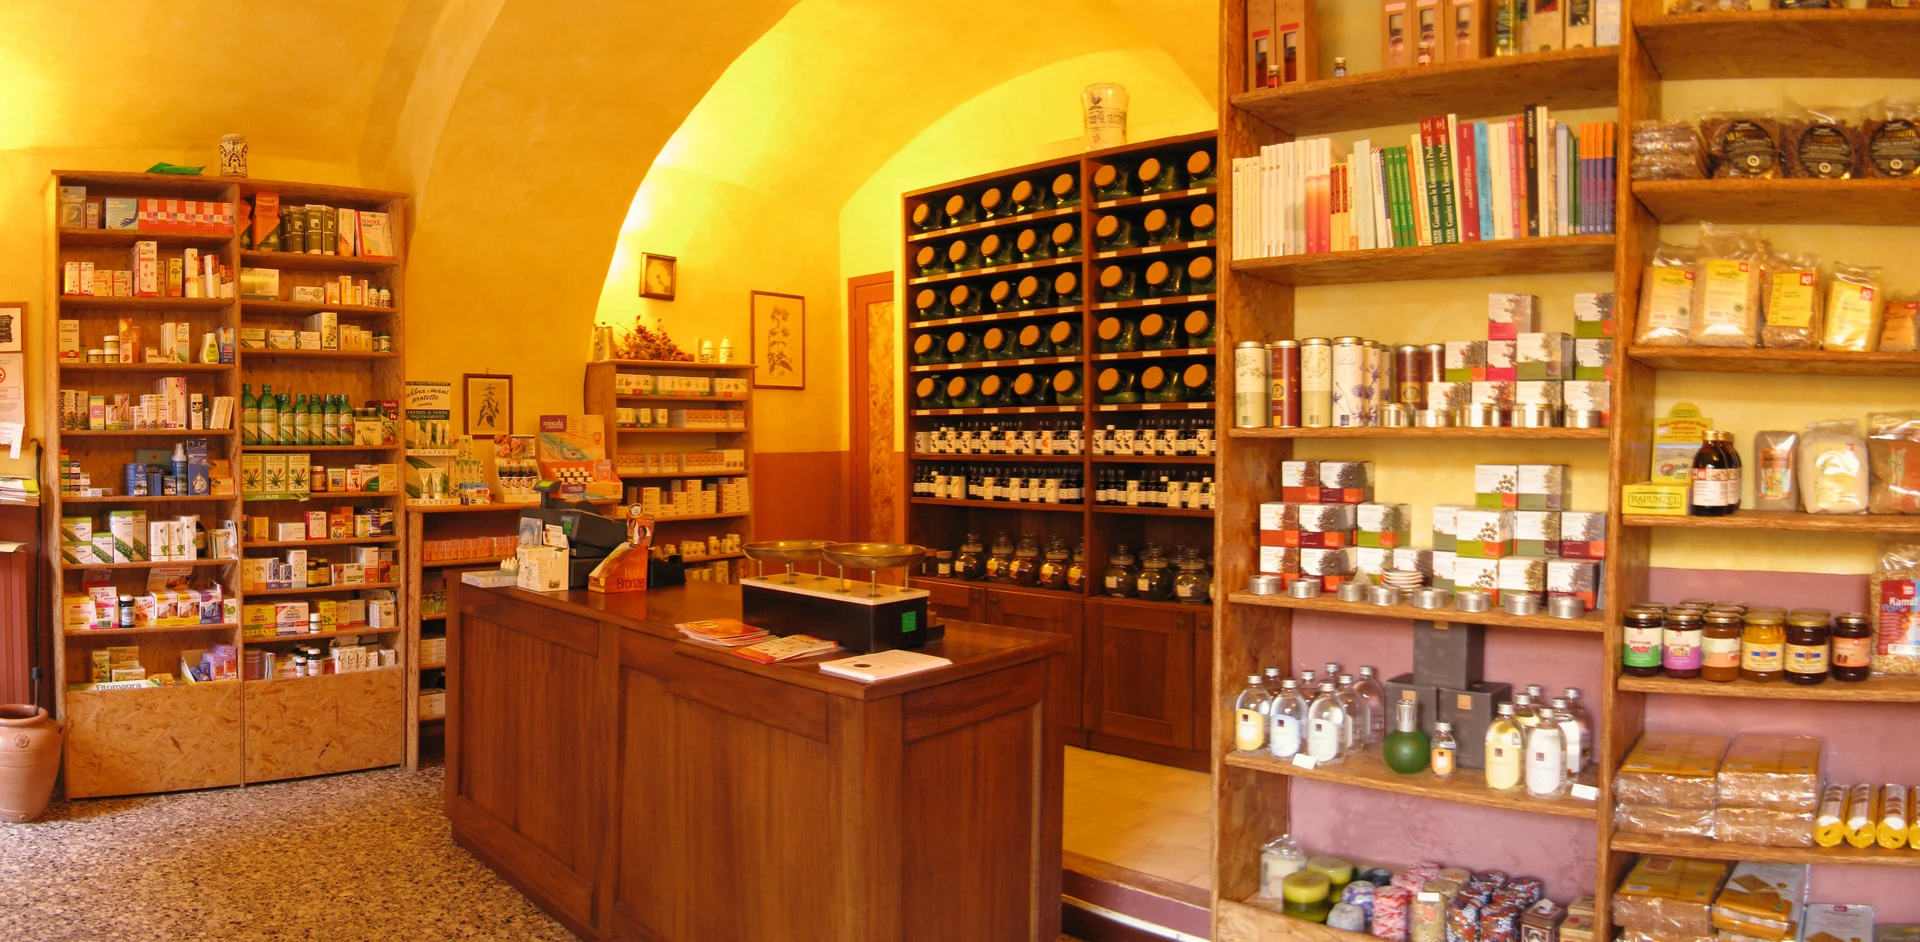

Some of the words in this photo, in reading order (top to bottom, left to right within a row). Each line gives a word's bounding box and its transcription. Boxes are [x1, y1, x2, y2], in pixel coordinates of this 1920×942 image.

[1425, 136, 1433, 159] Profumi
[1438, 134, 1446, 157] Profumi
[1428, 167, 1436, 188] Essenze
[1442, 165, 1450, 187] Essenze
[1432, 207, 1440, 228] Guarire
[1445, 206, 1453, 227] Guarire
[1769, 275, 1784, 325] CEREALI
[405, 387, 426, 398] abbra
[412, 394, 439, 405] protette
[1630, 495, 1679, 506] RAPUNZEL
[624, 568, 645, 578] Hydra
[616, 577, 645, 590] Bronze
[1889, 596, 1918, 606] Kamut
[96, 682, 142, 690] Fitomagra
